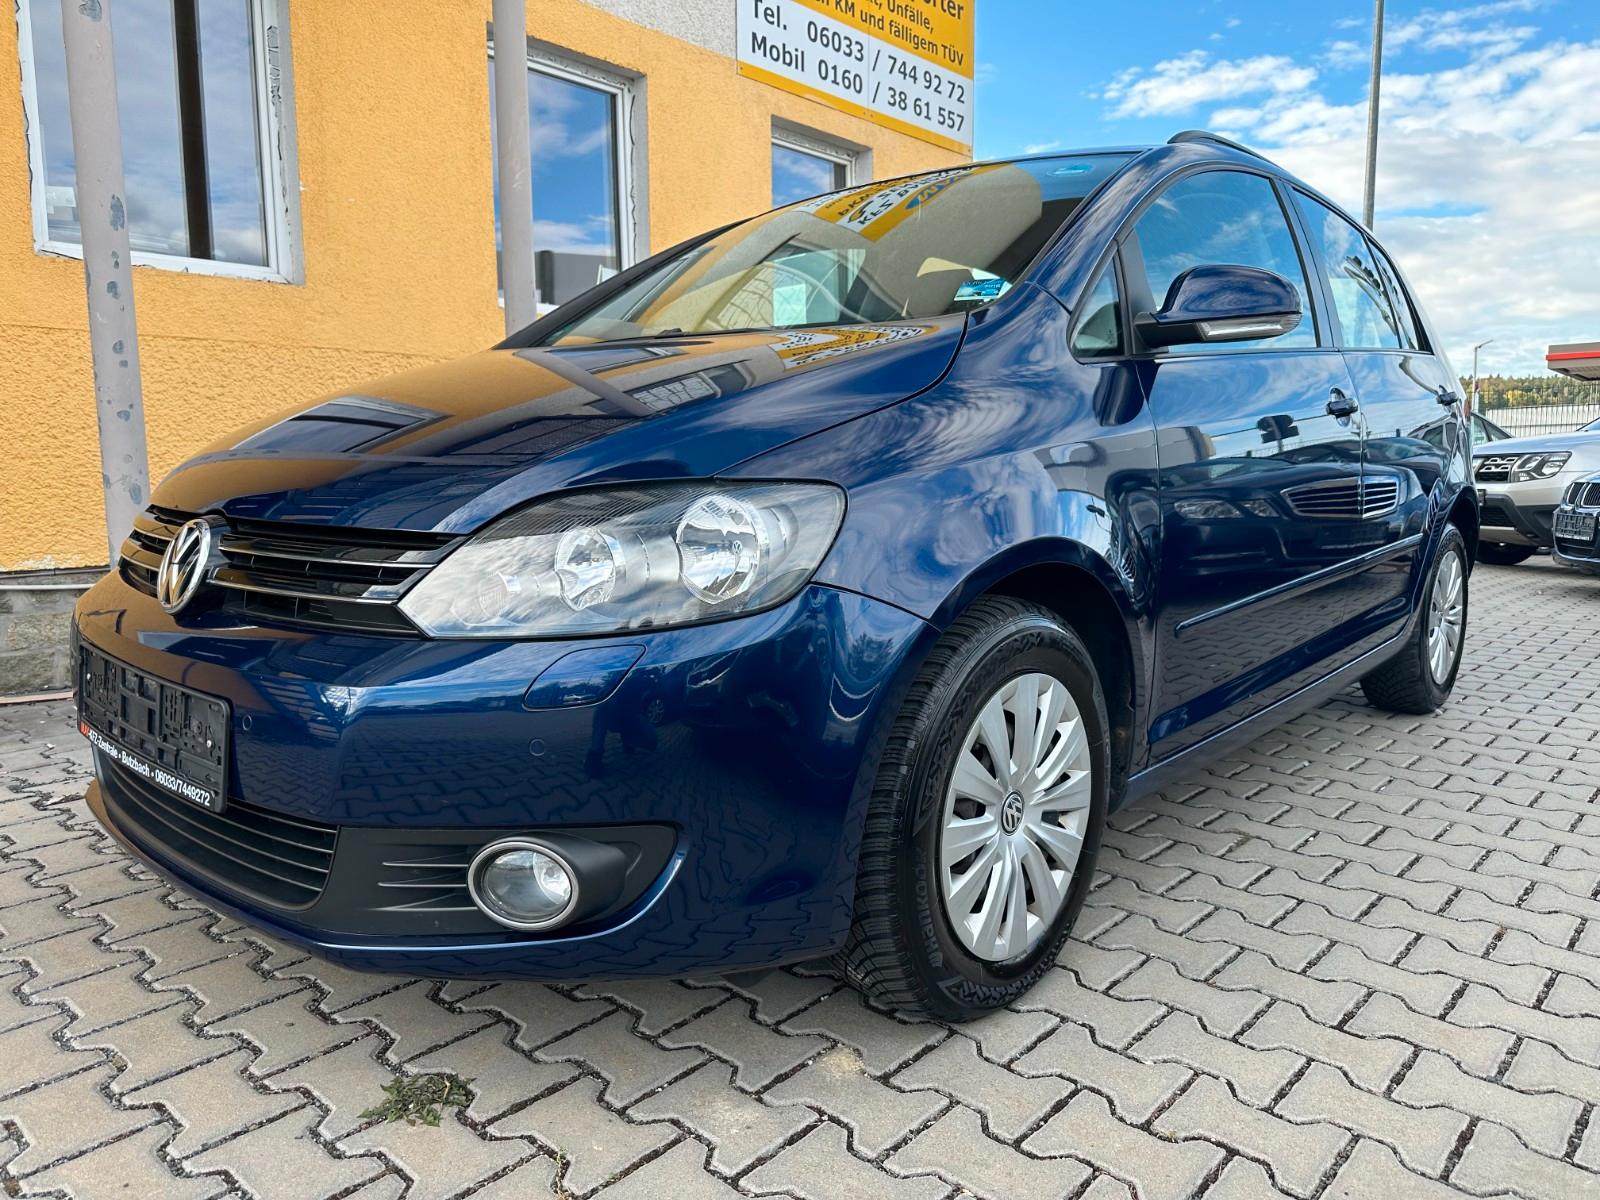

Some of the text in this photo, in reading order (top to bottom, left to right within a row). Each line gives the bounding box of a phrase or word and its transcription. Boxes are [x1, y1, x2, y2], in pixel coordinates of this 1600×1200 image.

[835, 0, 855, 18] KM
[860, 10, 884, 31] und
[889, 20, 938, 55] fälligem
[941, 43, 964, 66] TÜV
[887, 0, 933, 34] Unfälle,
[751, 31, 805, 72] Mobil
[818, 59, 863, 94] 0160
[887, 86, 907, 111] 38
[913, 97, 931, 120] 61
[938, 107, 965, 132] 557
[752, 0, 787, 30] Tel.
[807, 20, 864, 63] 06033
[887, 55, 918, 85] 744
[923, 70, 942, 95] 92
[947, 80, 965, 104] 72
[121, 750, 150, 778] Butzbach
[155, 769, 211, 806] 06033/7449272
